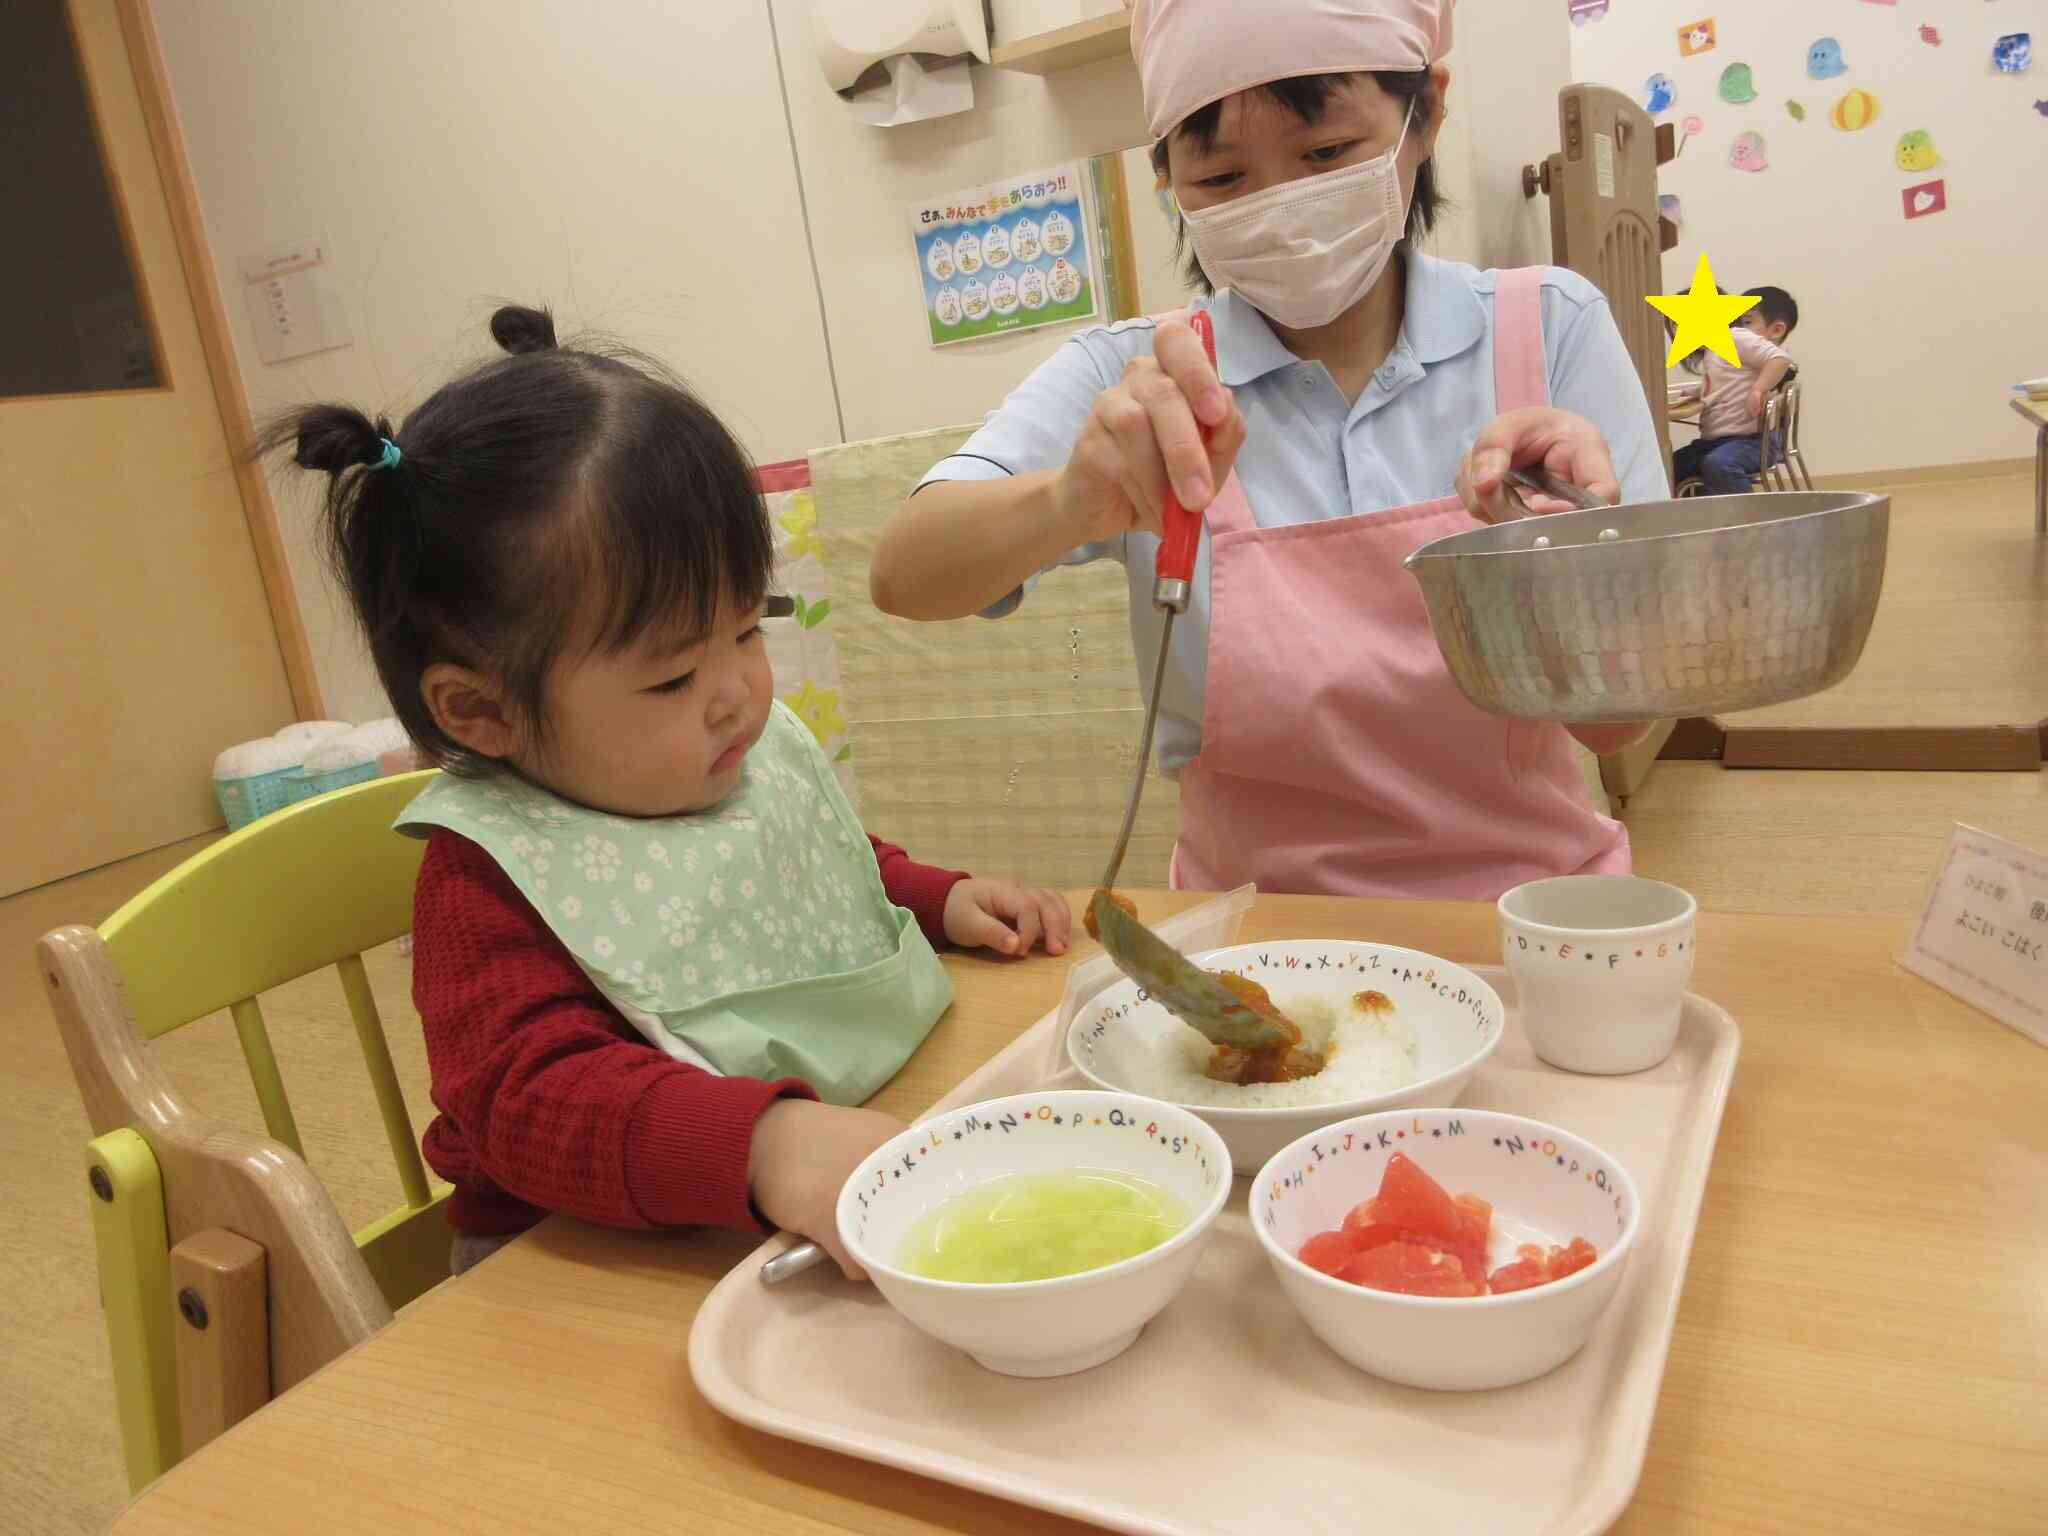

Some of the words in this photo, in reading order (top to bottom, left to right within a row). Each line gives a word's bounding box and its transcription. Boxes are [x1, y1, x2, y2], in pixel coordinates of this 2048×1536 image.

[1259, 953, 1269, 967] V
[1285, 955, 1300, 969] W
[1317, 954, 1331, 969] X
[1370, 954, 1382, 969] Z
[1402, 968, 1412, 982] A
[1458, 989, 1467, 1003] D
[1558, 944, 1572, 959] E
[1608, 954, 1619, 970] F
[875, 1169, 886, 1188] J
[902, 1153, 917, 1171] K
[929, 1130, 943, 1146] L
[965, 1114, 982, 1135] M
[998, 1112, 1018, 1133] N
[1037, 1105, 1053, 1121] O
[1108, 1109, 1126, 1127] Q
[1145, 1121, 1158, 1138] R
[1171, 1136, 1182, 1154] S
[1312, 1144, 1325, 1162] I
[1342, 1133, 1355, 1151] J
[1377, 1129, 1392, 1148] K
[1412, 1117, 1424, 1135] L
[1448, 1119, 1465, 1137] M
[1504, 1135, 1525, 1156] N
[1541, 1139, 1557, 1157] O
[1594, 1168, 1606, 1192] Q
